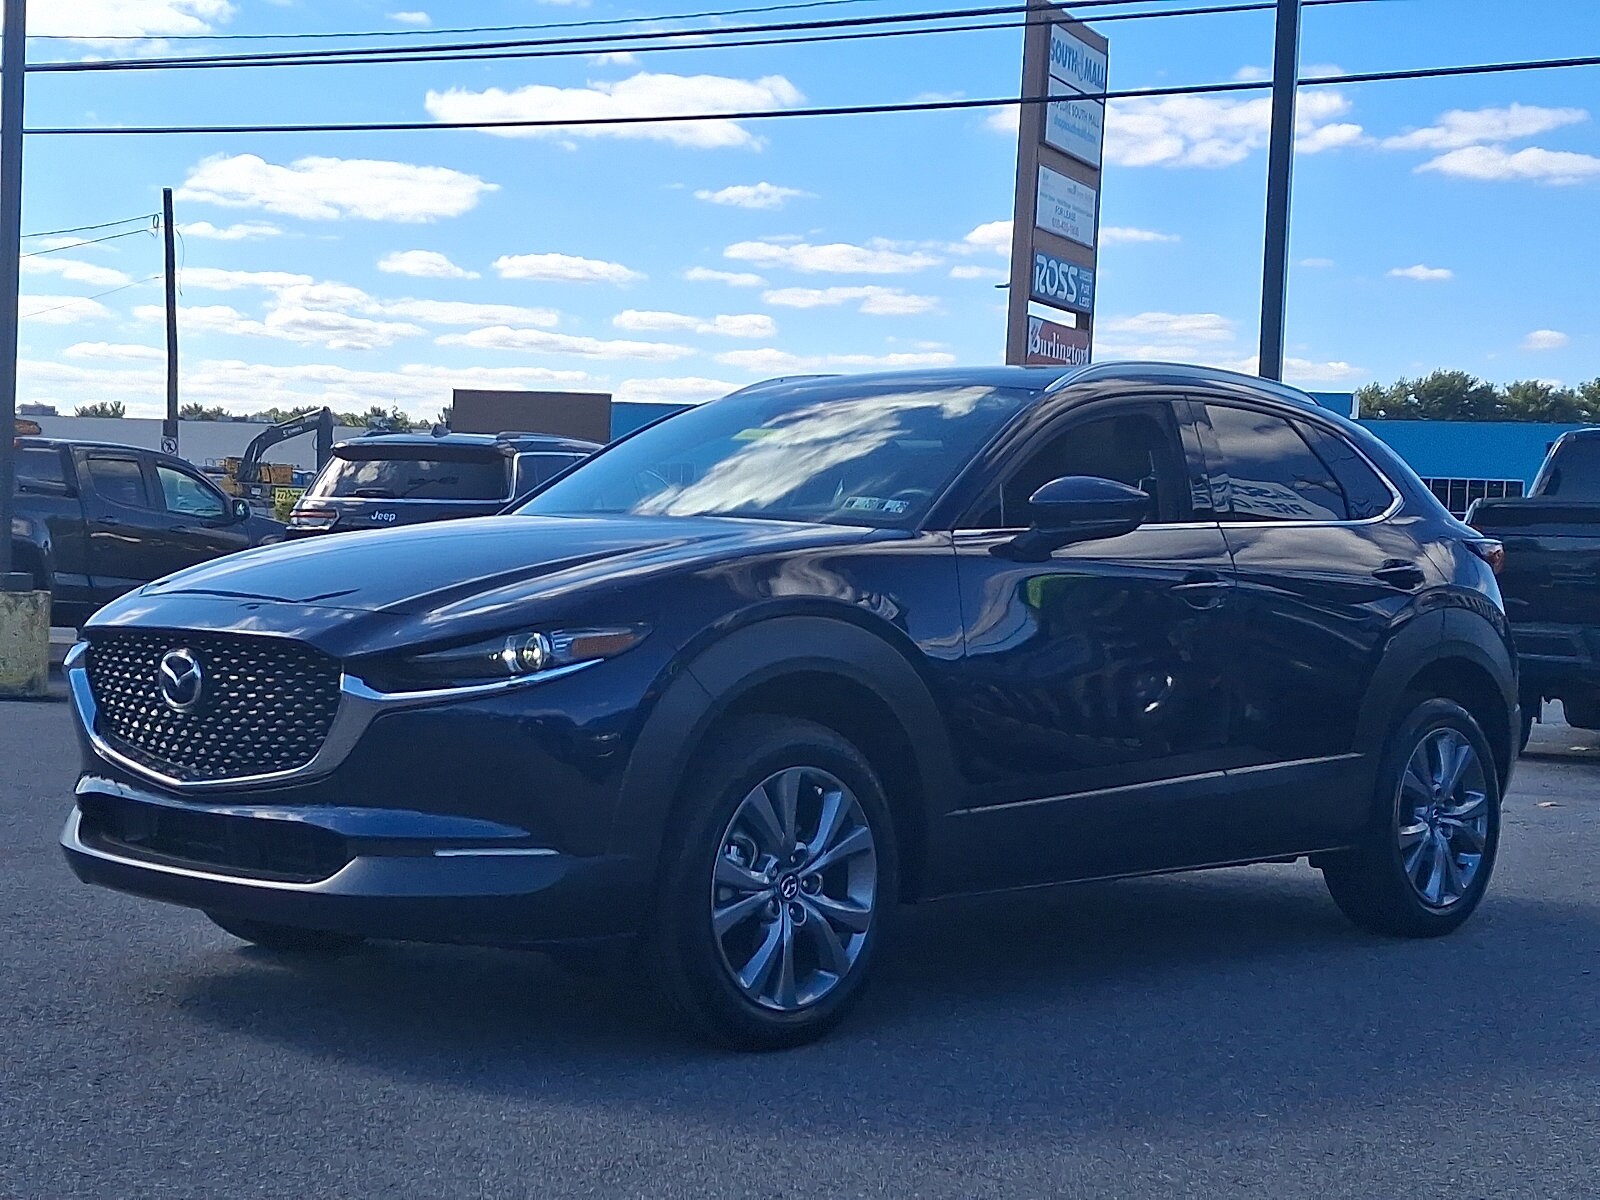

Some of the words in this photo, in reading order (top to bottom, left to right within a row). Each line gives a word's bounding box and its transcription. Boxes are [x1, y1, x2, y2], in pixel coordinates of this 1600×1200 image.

[1051, 37, 1078, 74] SOUTH
[1084, 57, 1106, 89] MALL
[1035, 254, 1078, 303] ROSS
[1027, 316, 1089, 366] Burlington
[371, 511, 396, 522] Jeep
